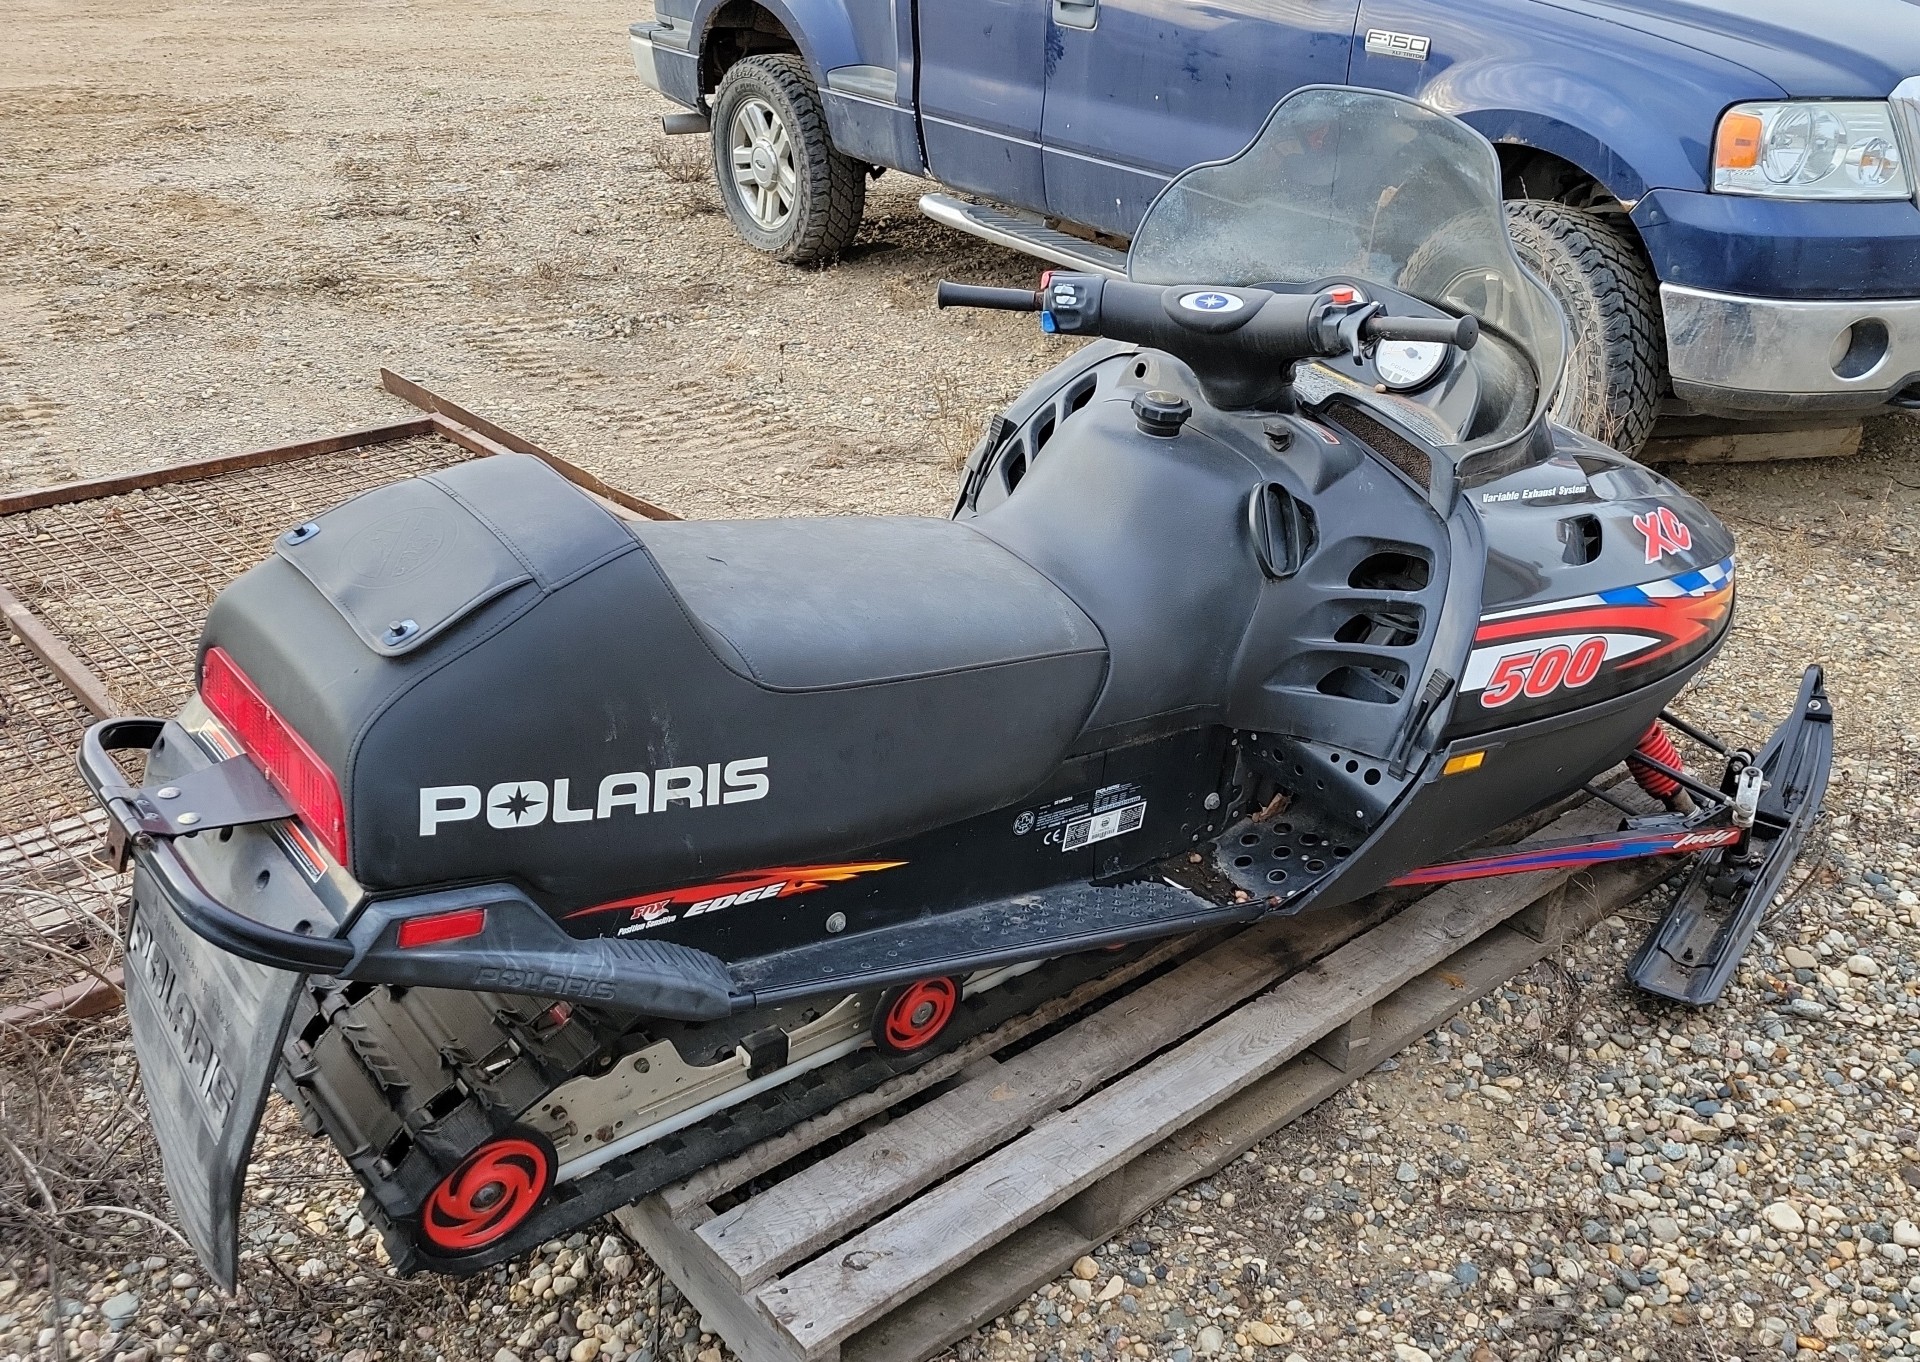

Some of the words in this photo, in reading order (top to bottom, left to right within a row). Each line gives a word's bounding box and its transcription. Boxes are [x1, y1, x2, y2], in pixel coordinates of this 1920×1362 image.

[1482, 491, 1520, 503] Variable
[1522, 487, 1556, 499] Exhaust
[1559, 485, 1587, 495] System
[1633, 506, 1692, 564] XC
[1480, 636, 1609, 709] 500
[419, 756, 770, 837] POLARIS
[1672, 829, 1738, 849] Indy
[630, 899, 671, 921] FOX
[683, 882, 786, 918] EDGE
[474, 966, 616, 1000] POLARIS
[129, 916, 236, 1128] POLARIS
